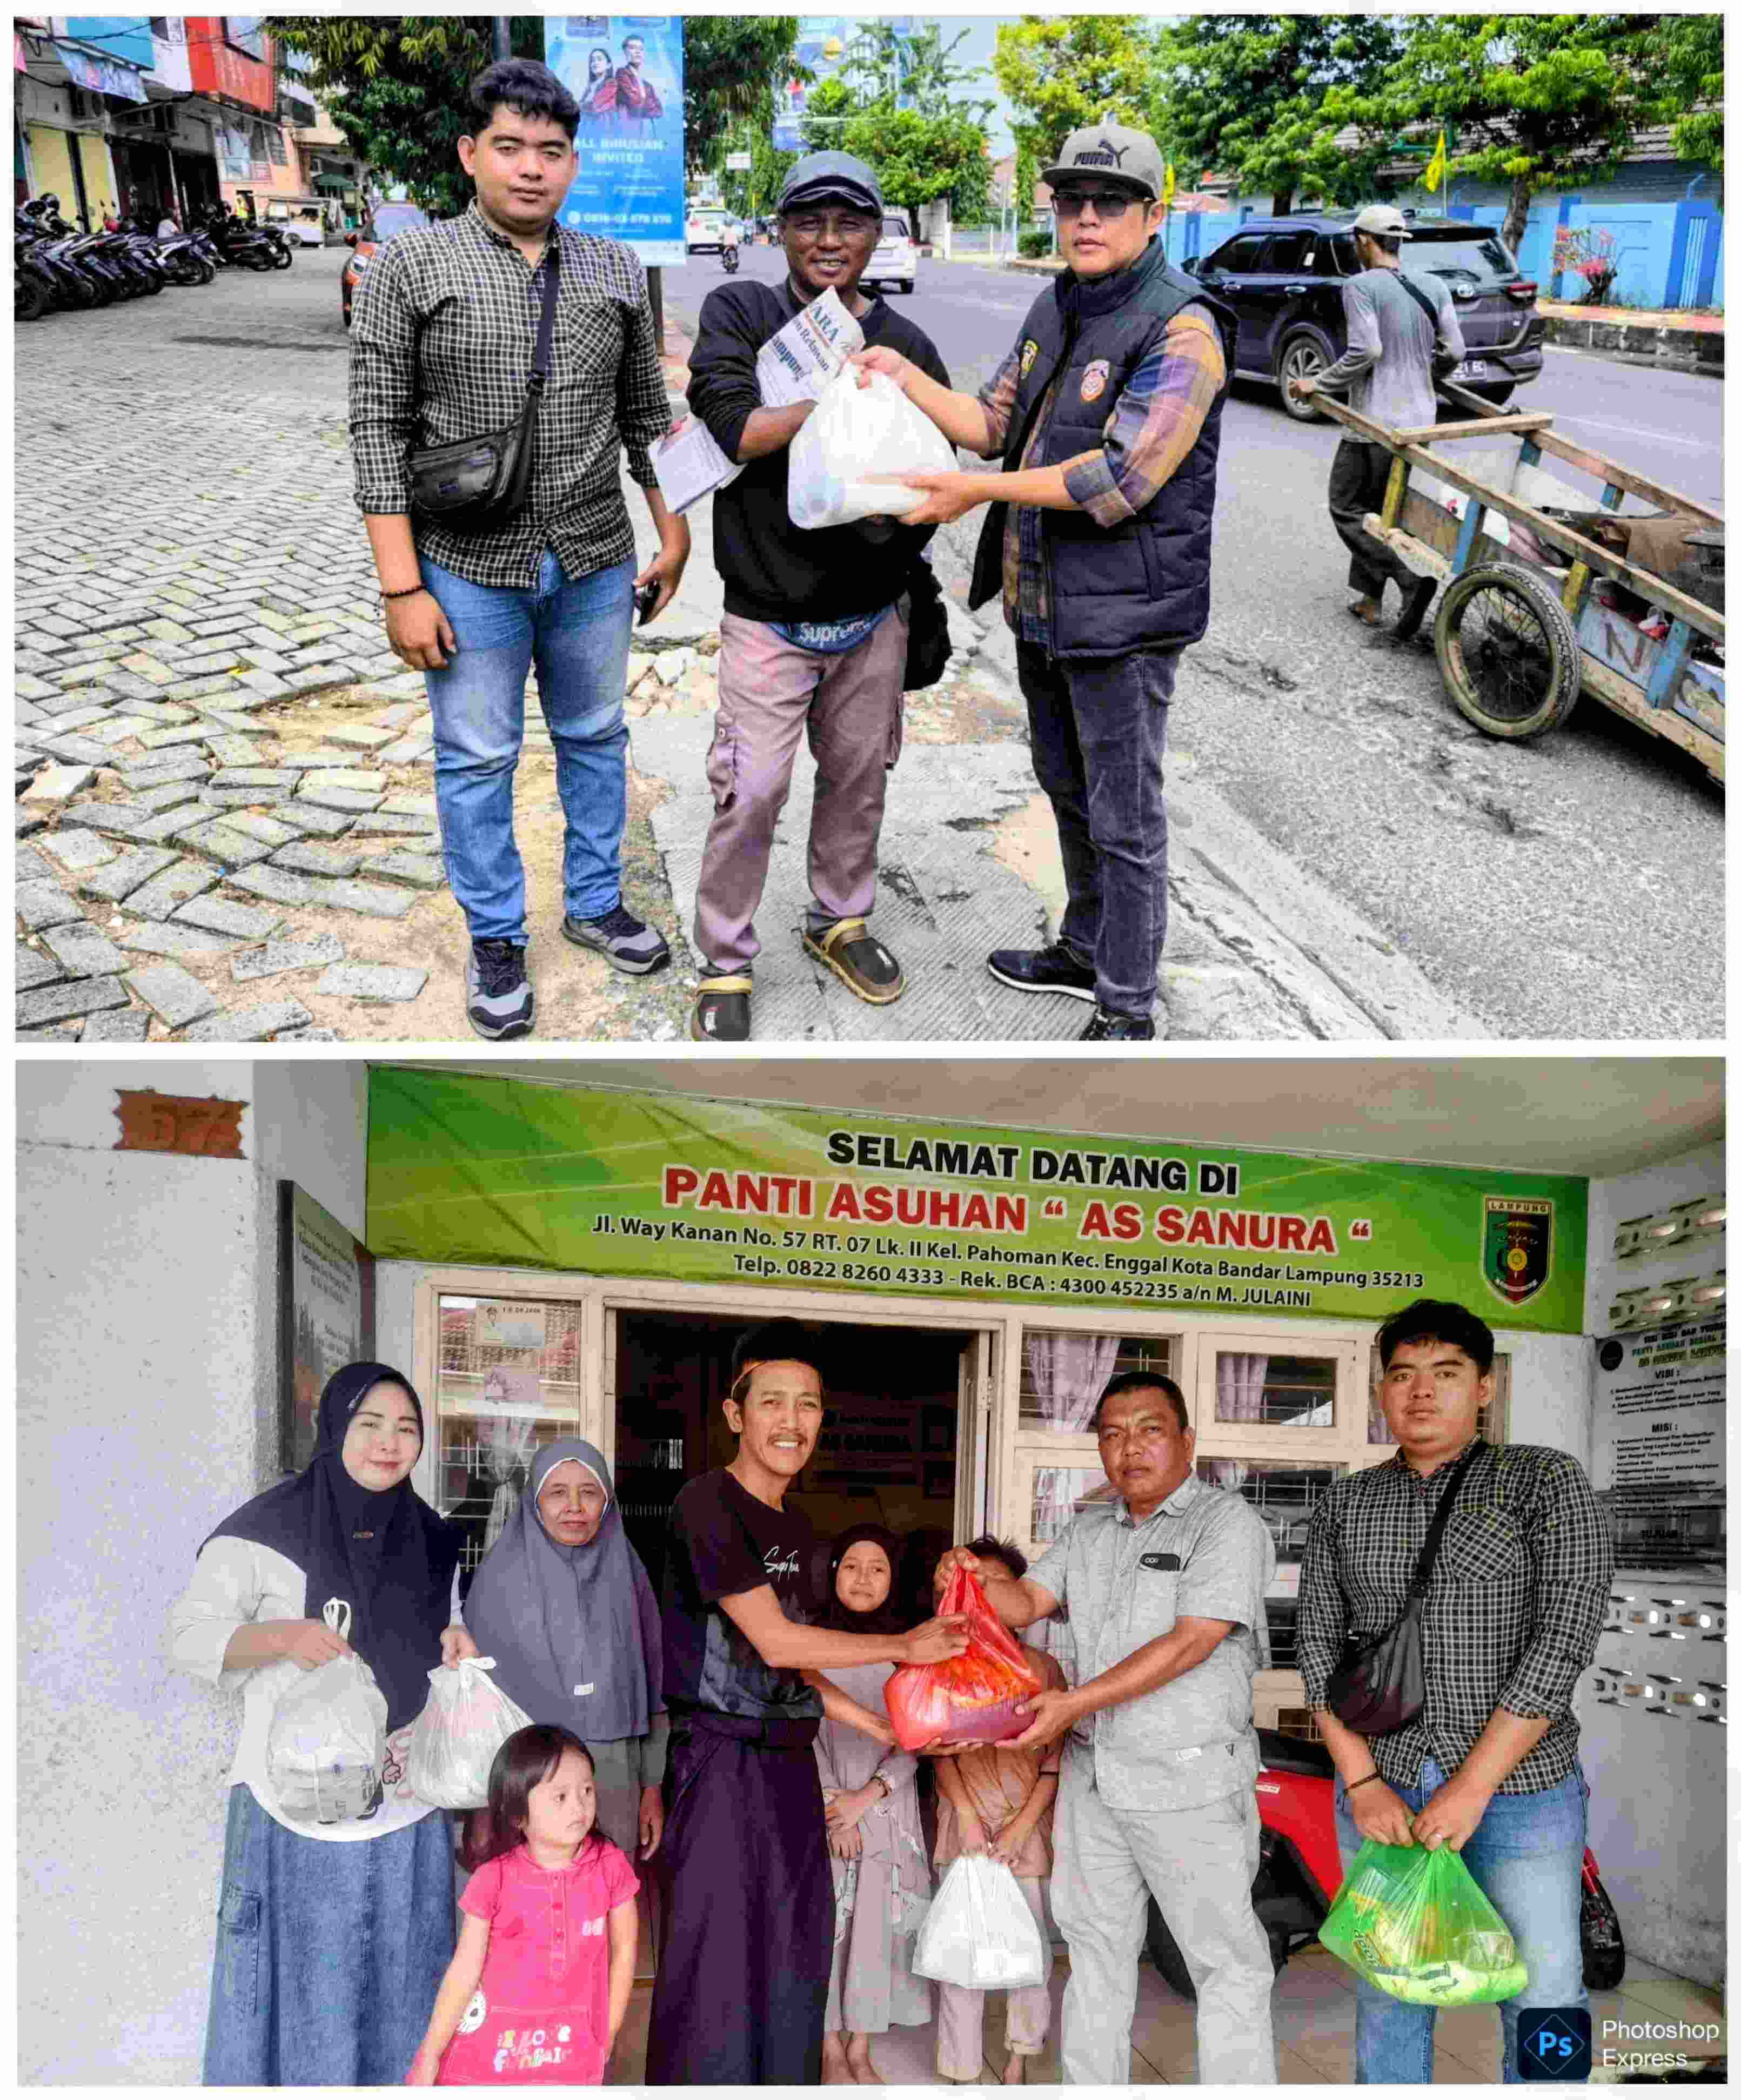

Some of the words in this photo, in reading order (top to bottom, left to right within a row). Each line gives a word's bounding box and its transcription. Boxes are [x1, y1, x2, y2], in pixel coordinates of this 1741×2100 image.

[1074, 151, 1114, 166] PUMA
[812, 304, 839, 343] ARA
[827, 1133, 1019, 1177] SELAMAT
[1033, 1150, 1186, 1191] DATANG
[1200, 1164, 1237, 1195] DI
[665, 1168, 812, 1216] PANTI
[828, 1183, 1026, 1231] ASUHAN
[1081, 1203, 1142, 1239] AS
[1156, 1208, 1336, 1253] SANURA
[1490, 1202, 1546, 1212] LAMPUNG
[593, 1216, 615, 1233] Jl.
[621, 1218, 665, 1241] Way
[672, 1222, 736, 1242] Kanan
[744, 1227, 776, 1246] No.
[782, 1231, 806, 1247] 57
[813, 1233, 841, 1251] RT.
[847, 1237, 870, 1253] 07
[876, 1238, 904, 1255] Lk.
[910, 1241, 921, 1256] II
[927, 1243, 961, 1259] Kel.
[968, 1245, 1056, 1265] Pahoman
[1062, 1251, 1099, 1268] Kec.
[1105, 1253, 1167, 1275] Enggal
[1172, 1258, 1213, 1275] Kota
[1218, 1260, 1281, 1279] Bandar
[1286, 1265, 1367, 1289] Lampung
[1372, 1271, 1423, 1288] 35213
[734, 1254, 781, 1277] Telp.
[787, 1259, 836, 1278] 0822
[842, 1264, 891, 1281] 8260
[896, 1268, 943, 1284] 4333
[961, 1271, 1001, 1287] Rek.
[1007, 1274, 1044, 1291] BCA
[1060, 1278, 1106, 1294] 4300
[1110, 1281, 1177, 1298] 452235
[1183, 1285, 1211, 1300] a/n
[1216, 1286, 1237, 1303] M.
[1242, 1289, 1311, 1306] JULAINI
